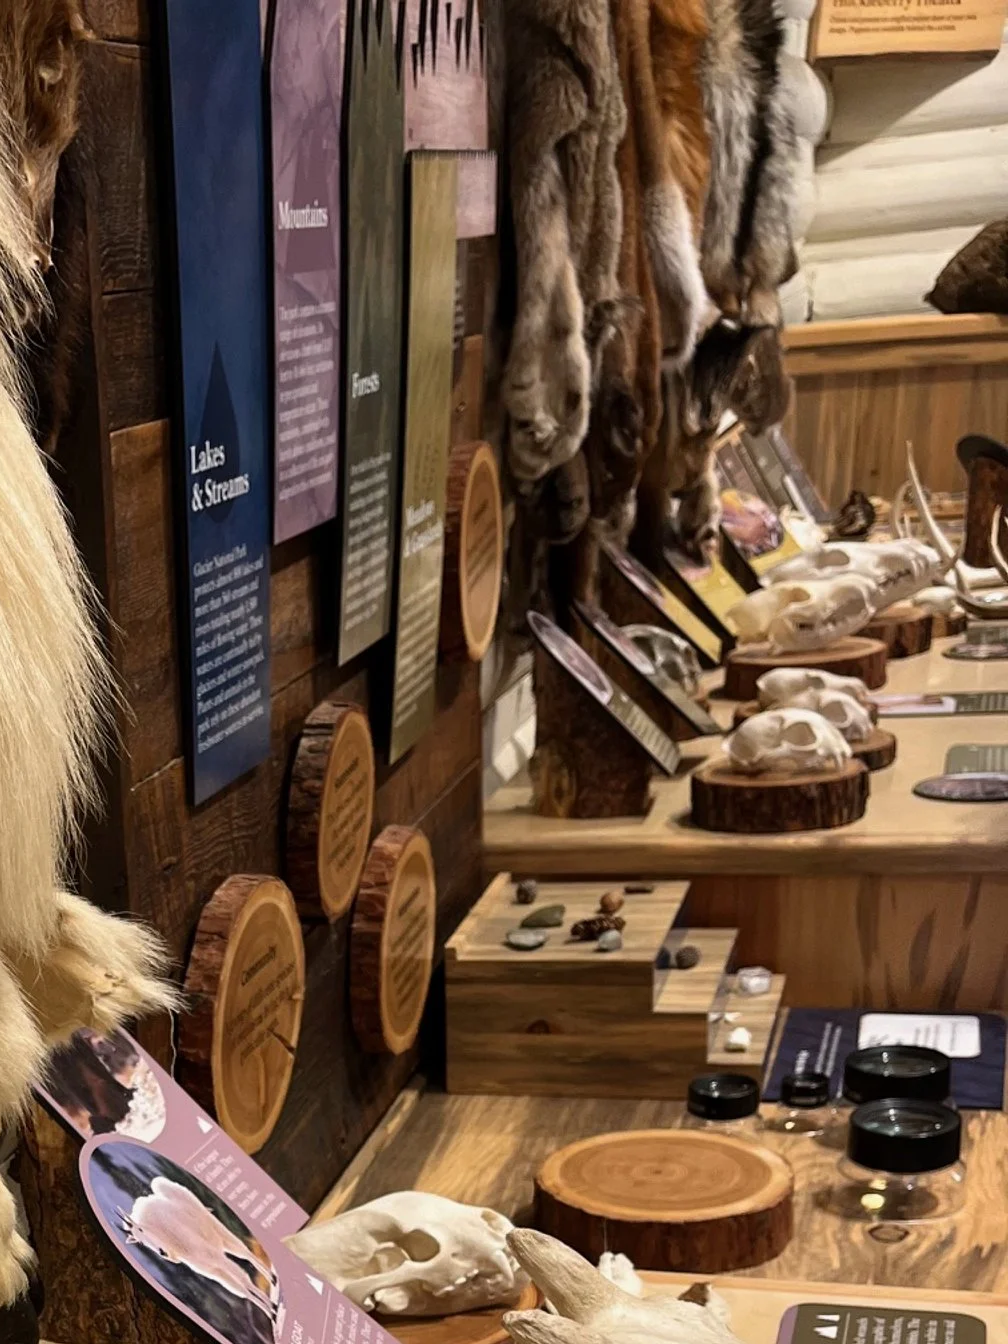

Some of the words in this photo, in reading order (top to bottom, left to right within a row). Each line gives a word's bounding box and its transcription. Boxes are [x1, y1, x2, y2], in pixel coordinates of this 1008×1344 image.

[278, 199, 329, 229] Mountains
[352, 371, 381, 399] Forests
[190, 440, 225, 474] Lakes
[191, 481, 204, 512] &
[205, 473, 250, 508] Streams
[292, 1320, 303, 1344] GOAT
